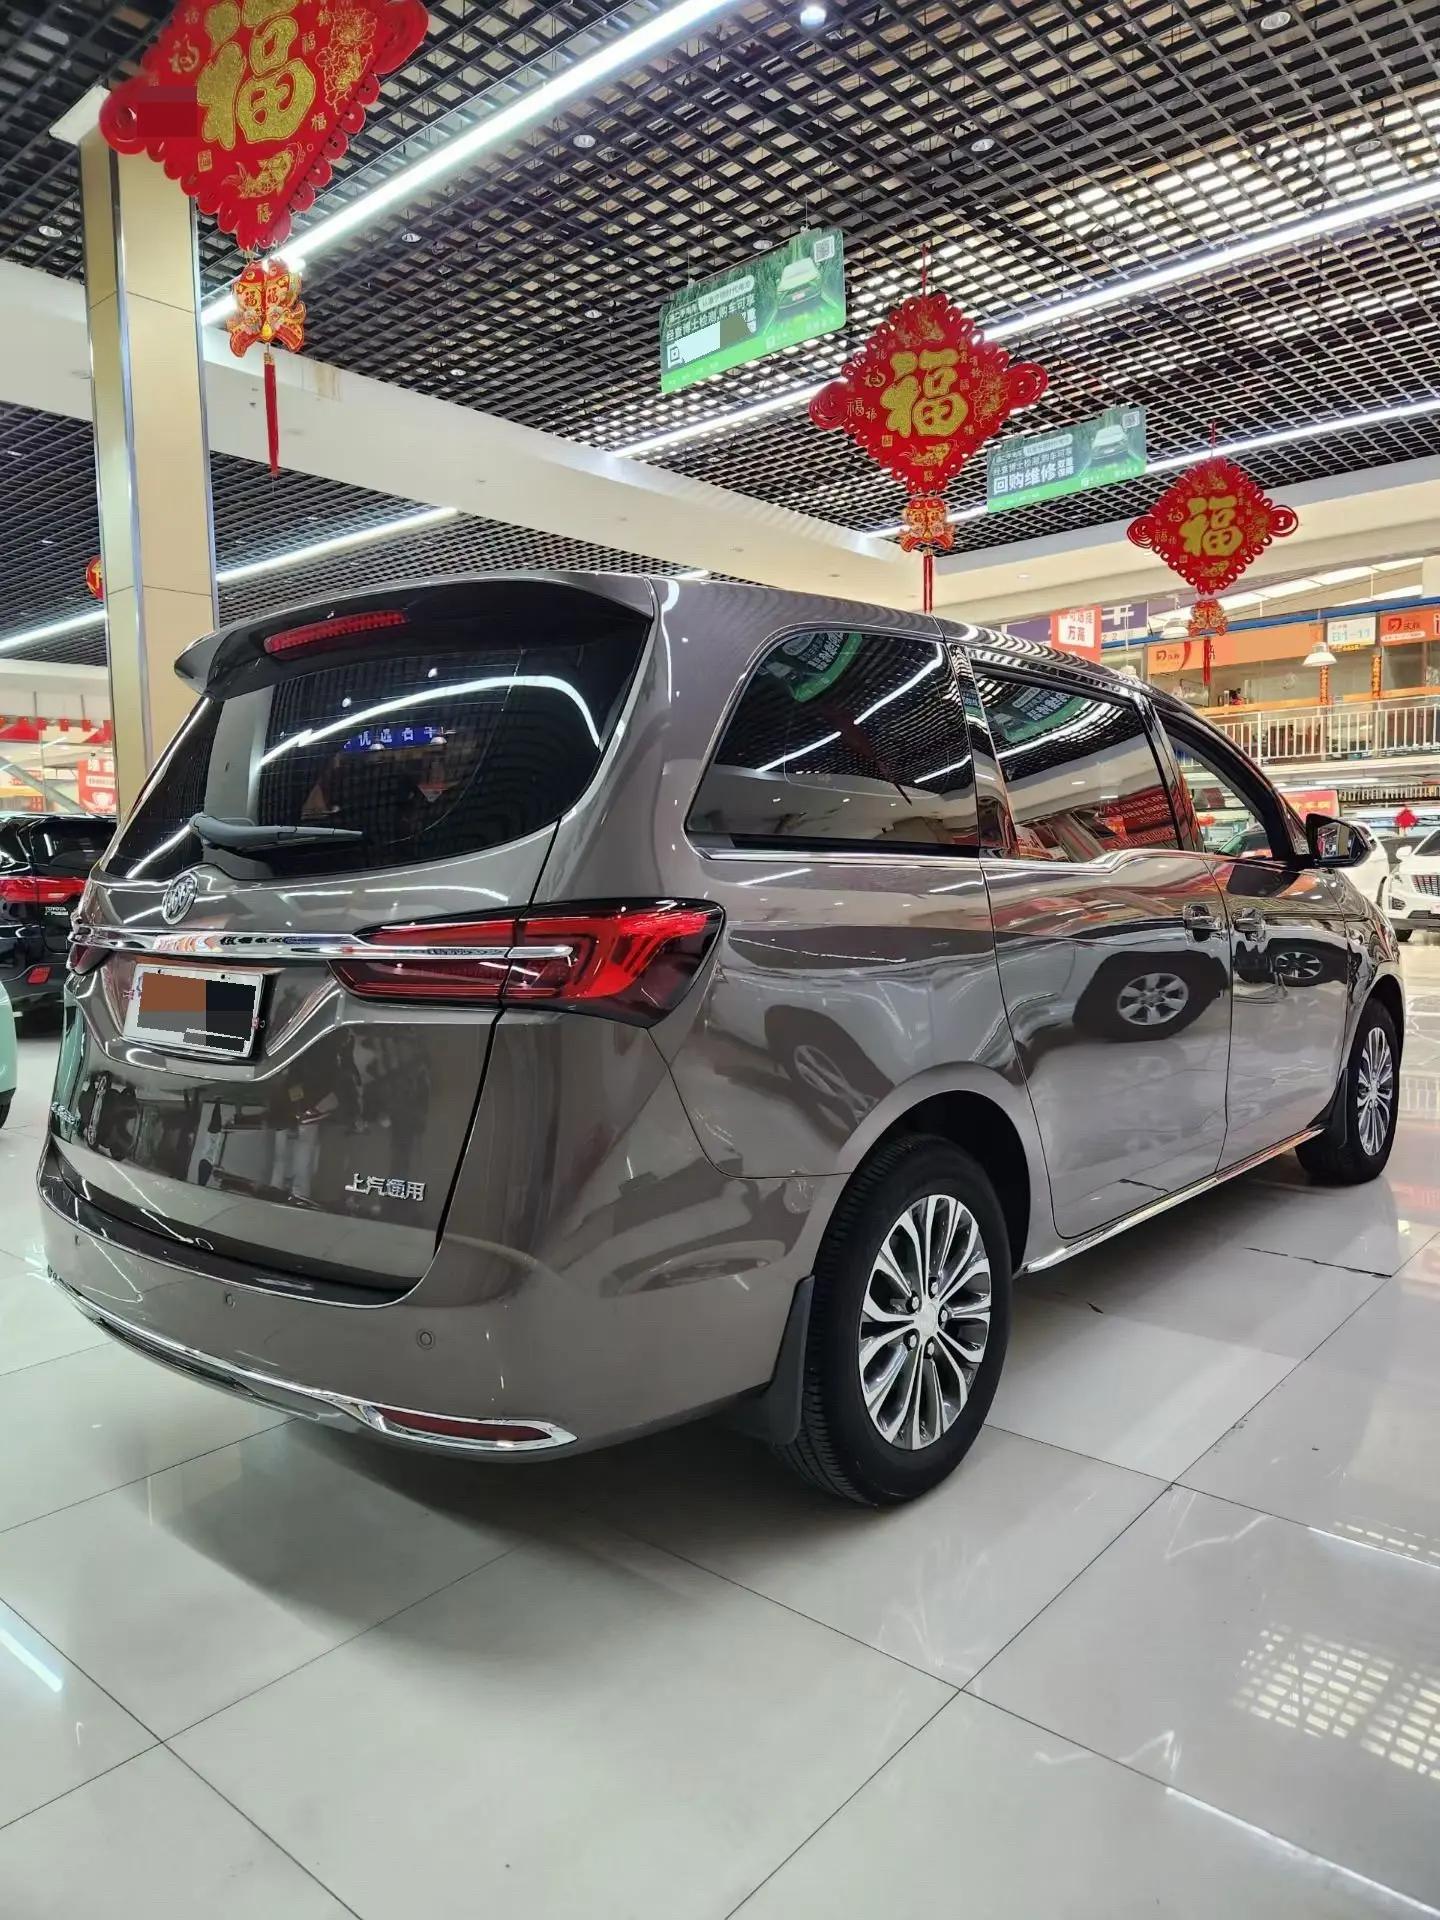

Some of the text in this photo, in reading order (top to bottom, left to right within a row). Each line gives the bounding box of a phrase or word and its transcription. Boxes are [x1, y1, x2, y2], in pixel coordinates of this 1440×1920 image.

[196, 0, 316, 151] 福
[879, 348, 969, 438] 福
[993, 463, 1056, 495] 回购维修
[1178, 495, 1244, 558] 福
[344, 1172, 427, 1202] 上汽通用
